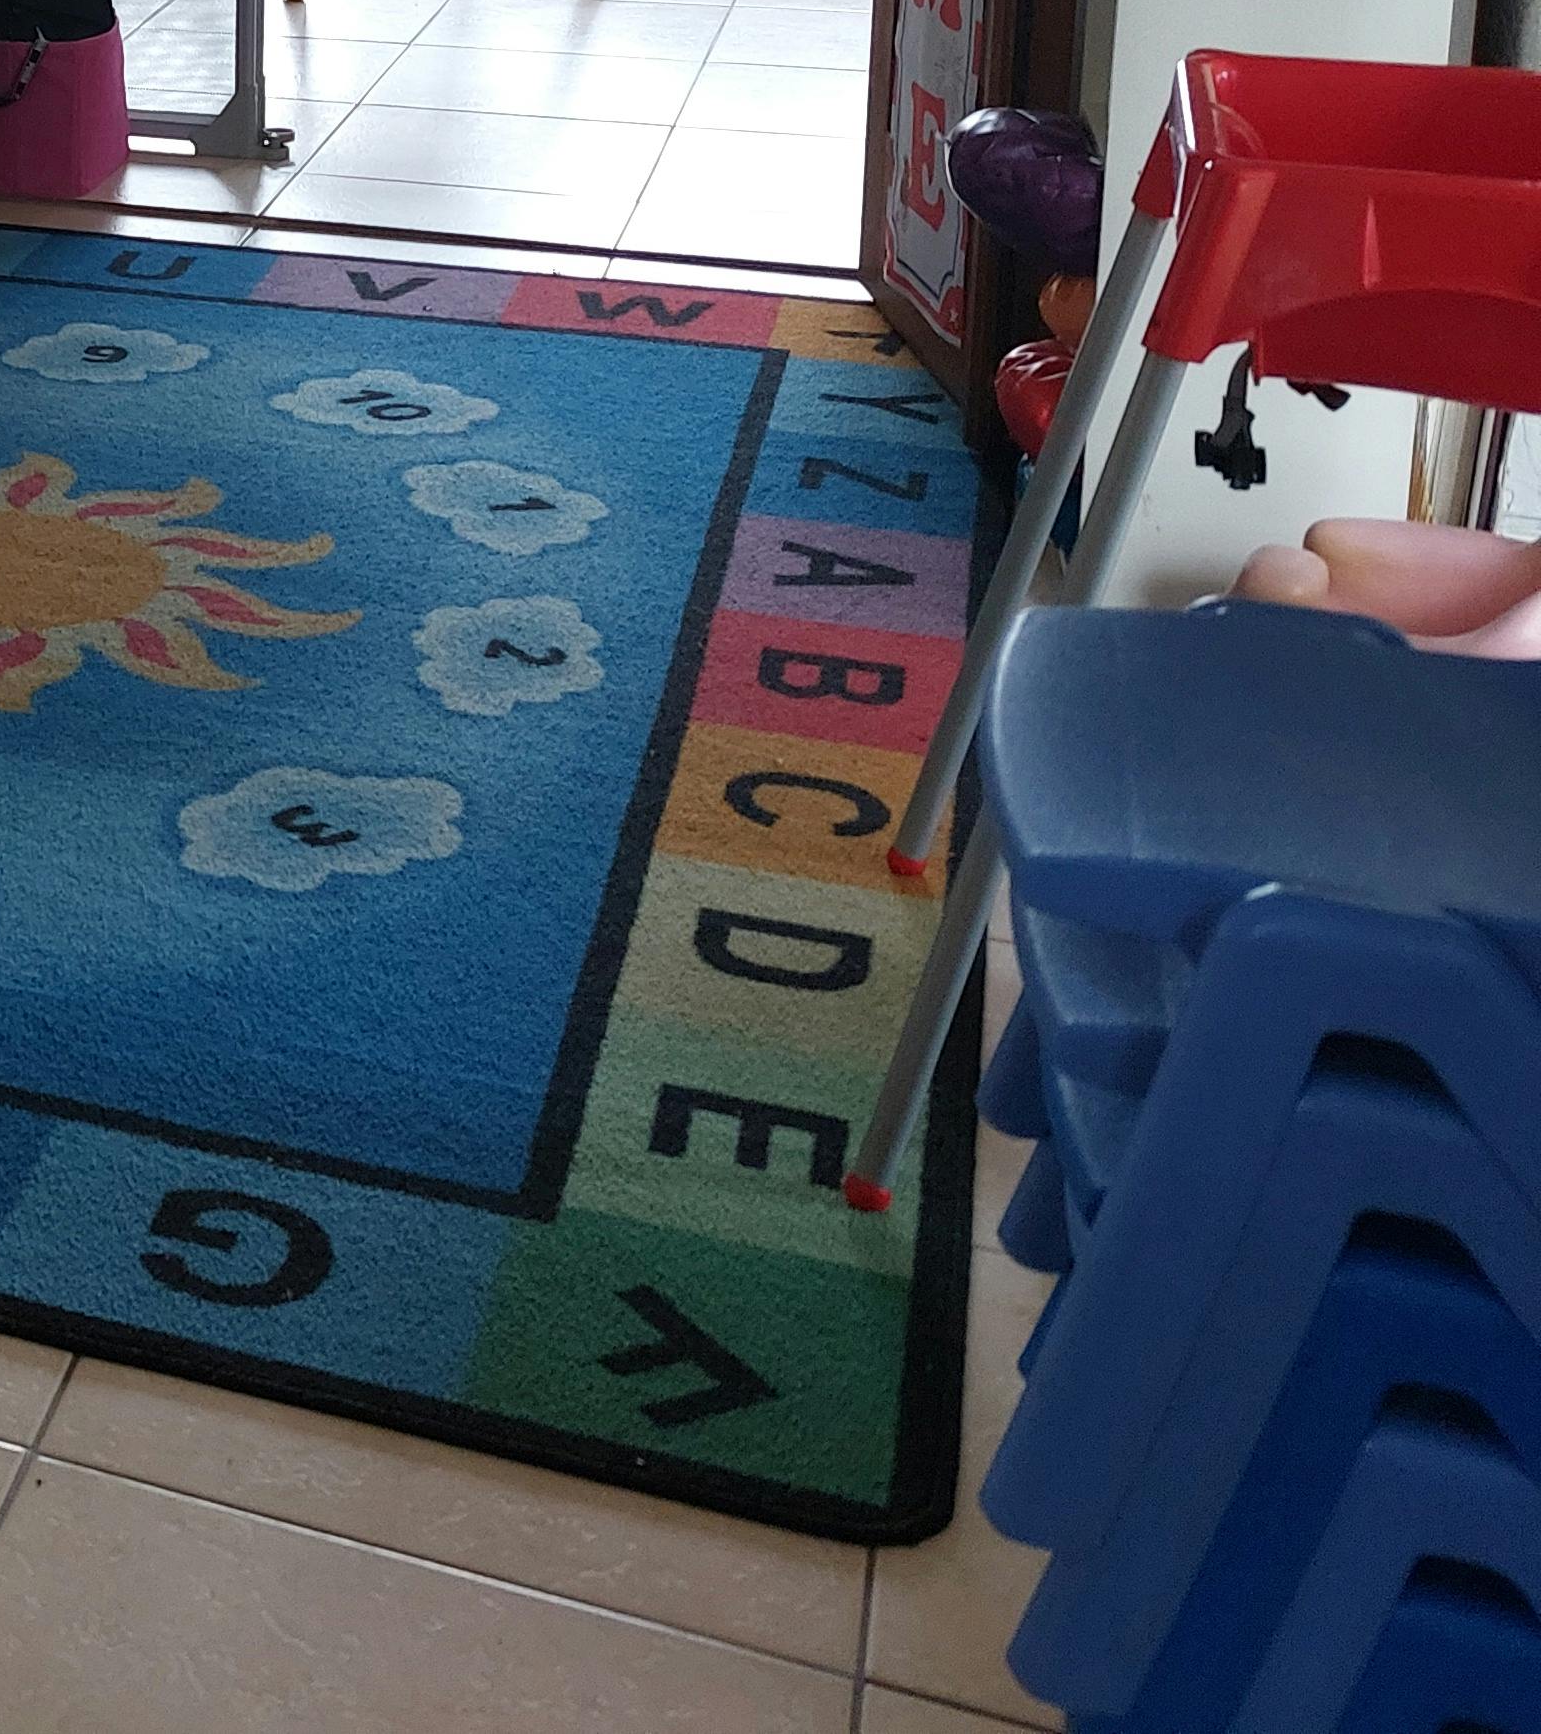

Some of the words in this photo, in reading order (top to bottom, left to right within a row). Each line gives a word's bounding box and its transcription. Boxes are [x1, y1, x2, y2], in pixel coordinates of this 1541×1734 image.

[772, 539, 916, 587] A
[758, 645, 905, 707] B
[723, 771, 891, 837] C
[693, 906, 874, 993] D
[647, 1082, 851, 1188] E
[137, 1187, 336, 1310] G
[597, 1283, 780, 1428] F
